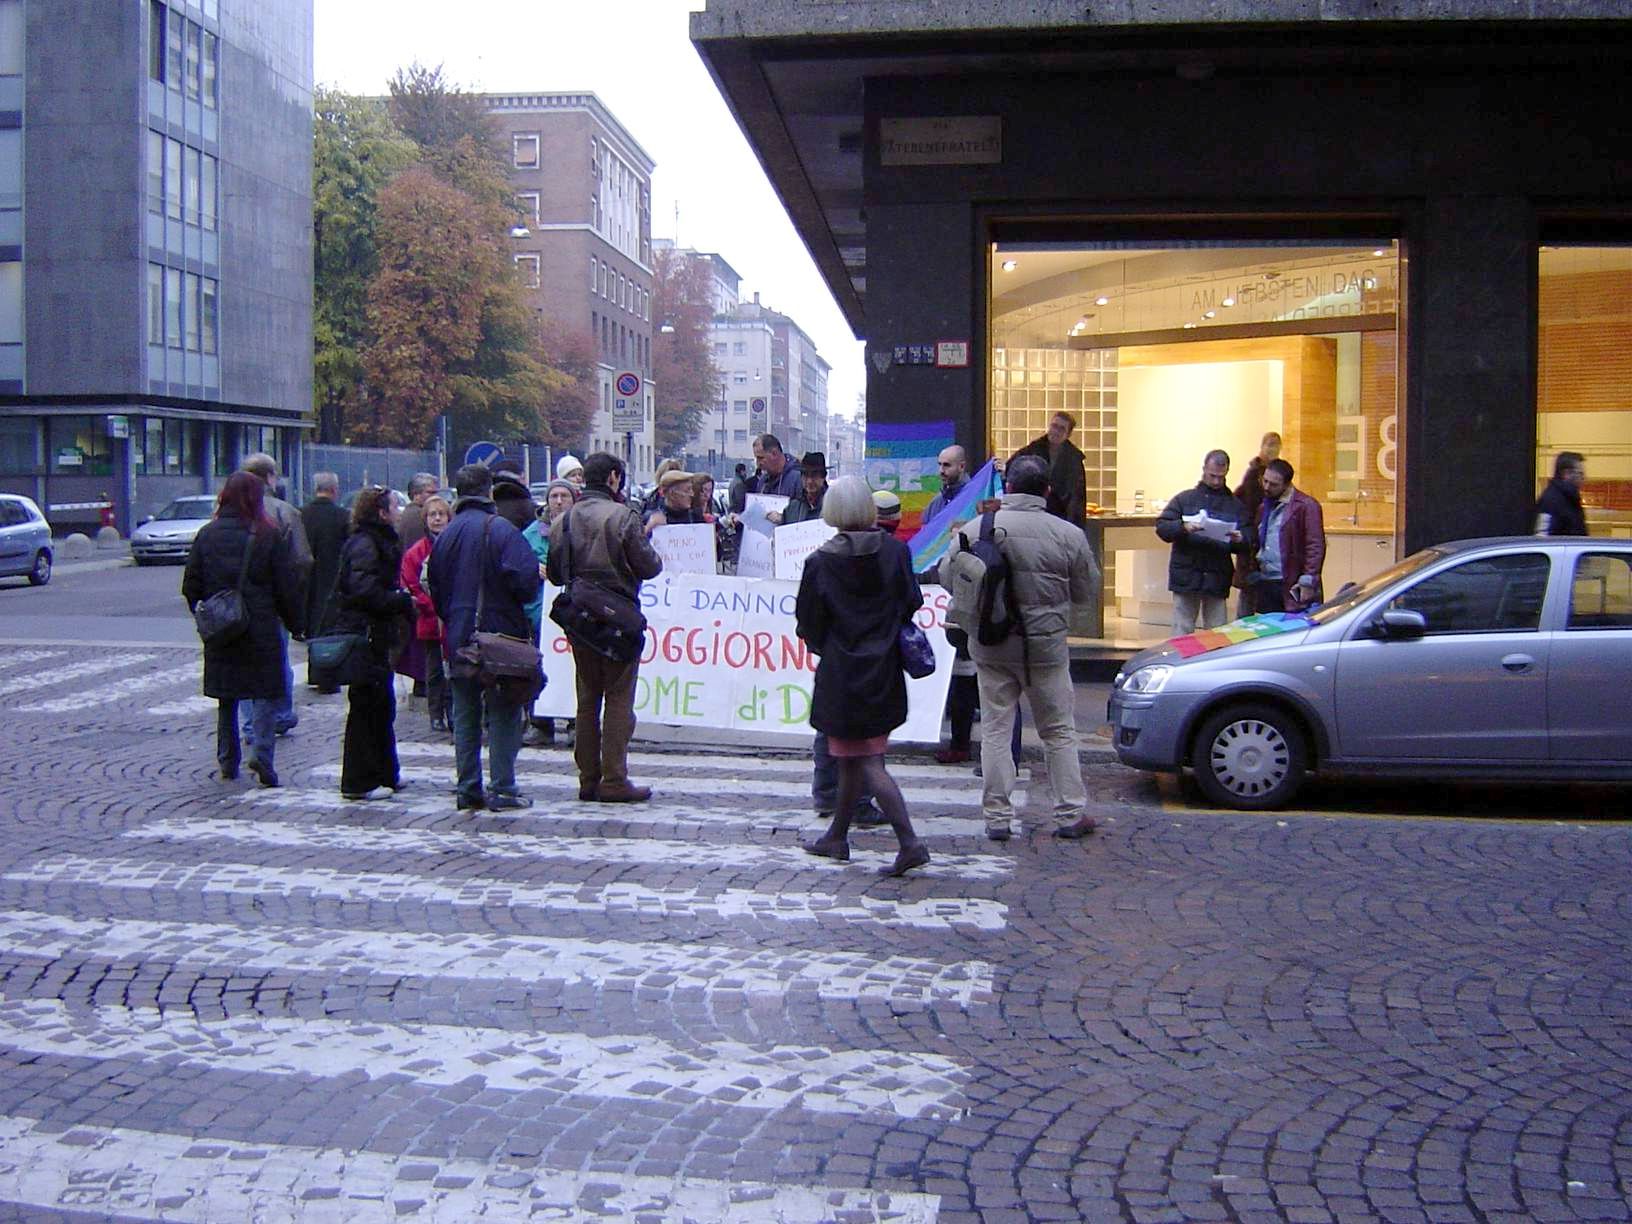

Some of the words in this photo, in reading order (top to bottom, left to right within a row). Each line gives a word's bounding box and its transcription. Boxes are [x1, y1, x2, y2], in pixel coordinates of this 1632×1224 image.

[866, 459, 922, 491] CE
[691, 589, 796, 616] DANNO
[634, 676, 704, 718] OME
[775, 682, 813, 725] D
